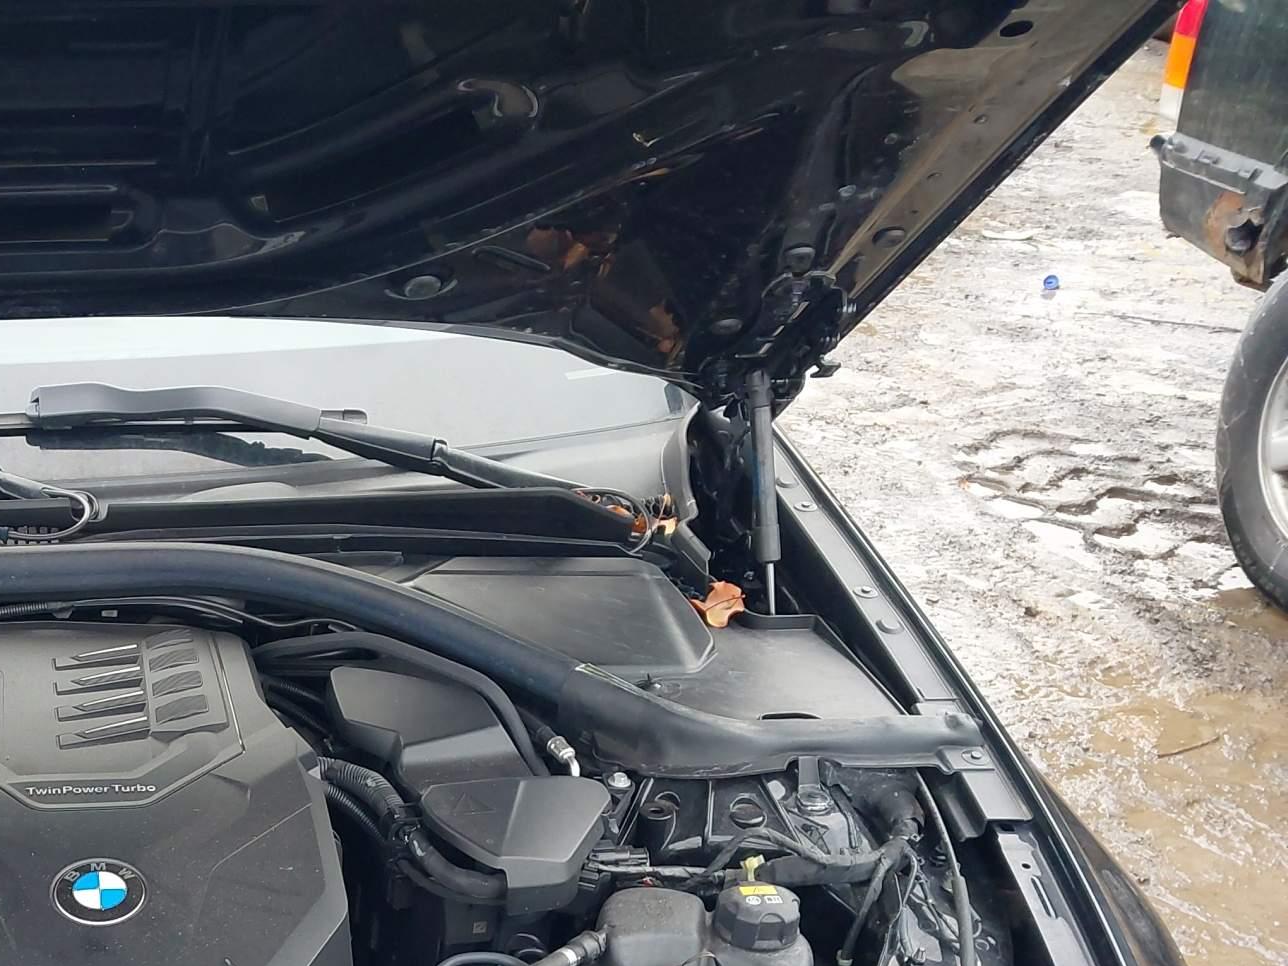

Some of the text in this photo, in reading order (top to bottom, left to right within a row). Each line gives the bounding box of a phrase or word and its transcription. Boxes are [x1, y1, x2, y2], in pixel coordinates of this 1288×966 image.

[26, 784, 156, 796] TwinPower Turbo
[64, 862, 136, 882] BMW
